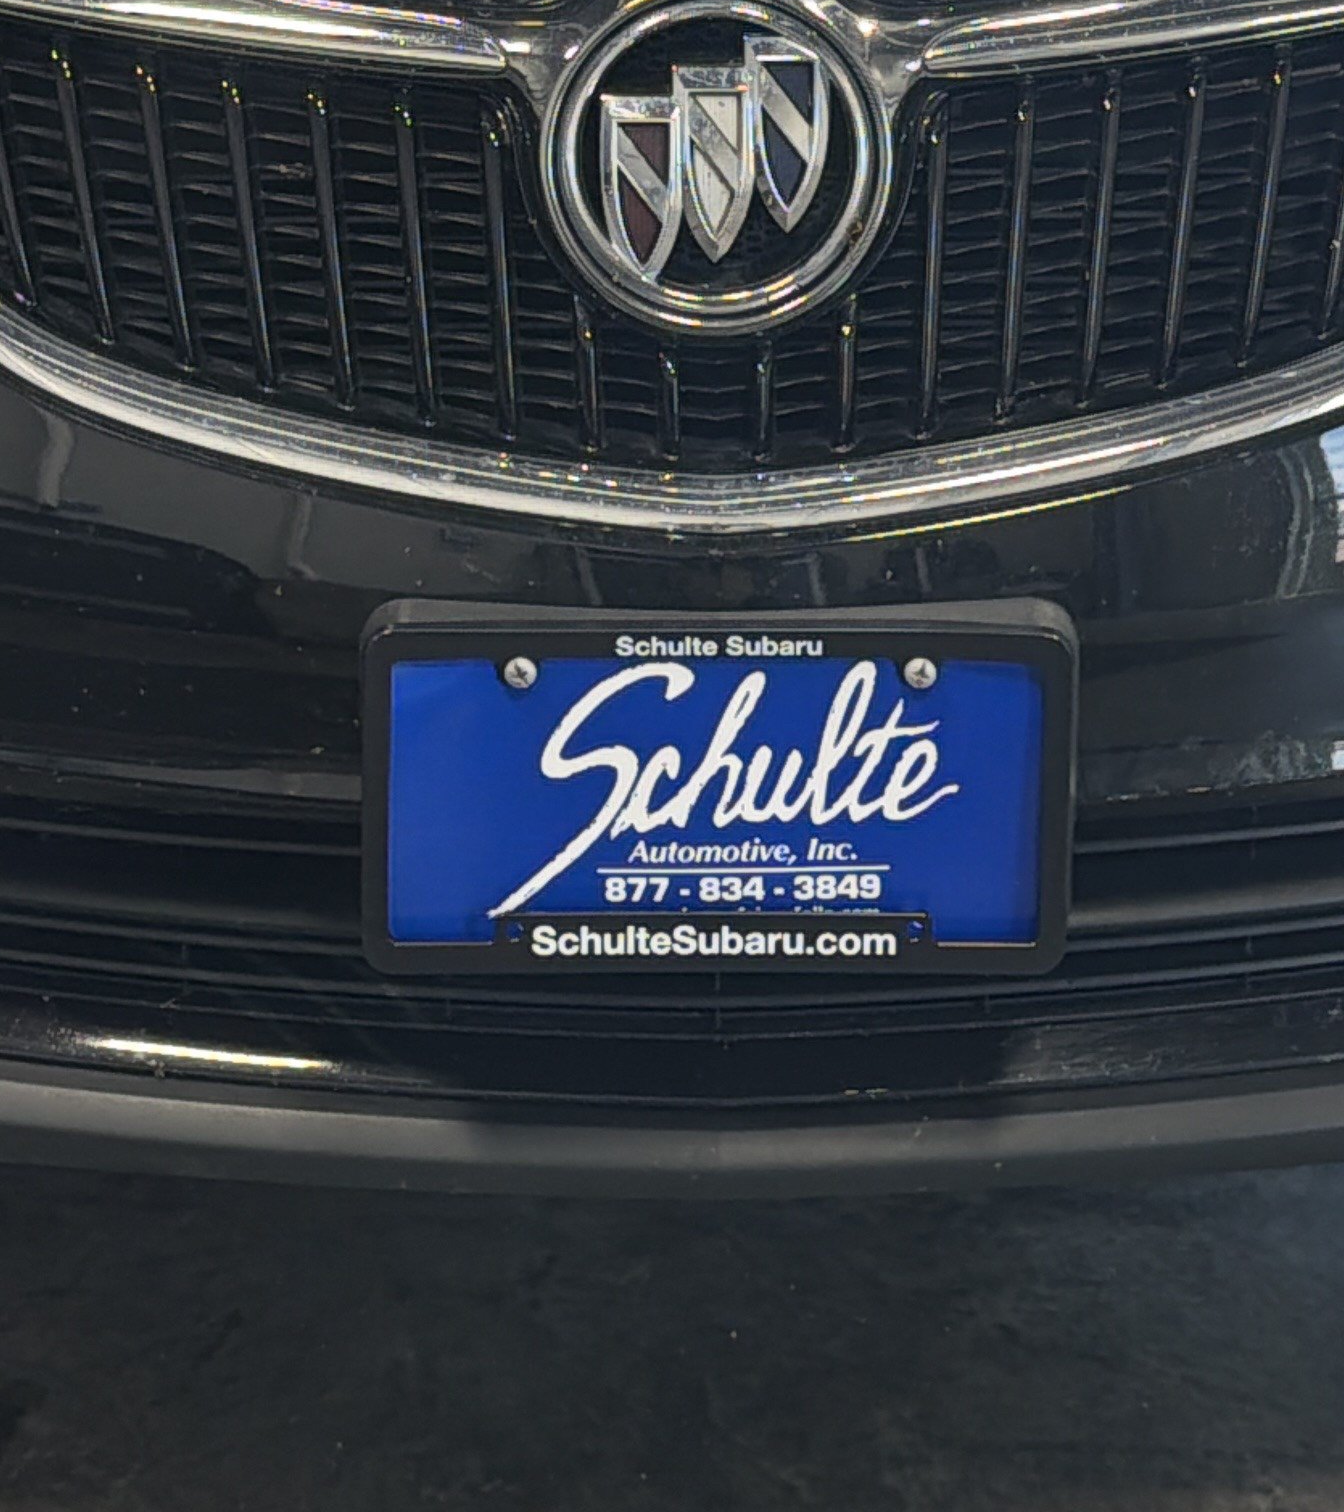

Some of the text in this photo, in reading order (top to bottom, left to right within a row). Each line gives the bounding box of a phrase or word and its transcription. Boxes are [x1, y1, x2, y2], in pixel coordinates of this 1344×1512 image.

[614, 635, 824, 657] Schulte Subaru
[487, 661, 960, 919] Schulte
[627, 837, 858, 865] Automotive, Inc.
[605, 876, 670, 903] 877
[698, 875, 766, 902] 834
[792, 873, 882, 901] 3849
[530, 924, 898, 956] SchulteSubaru.com
